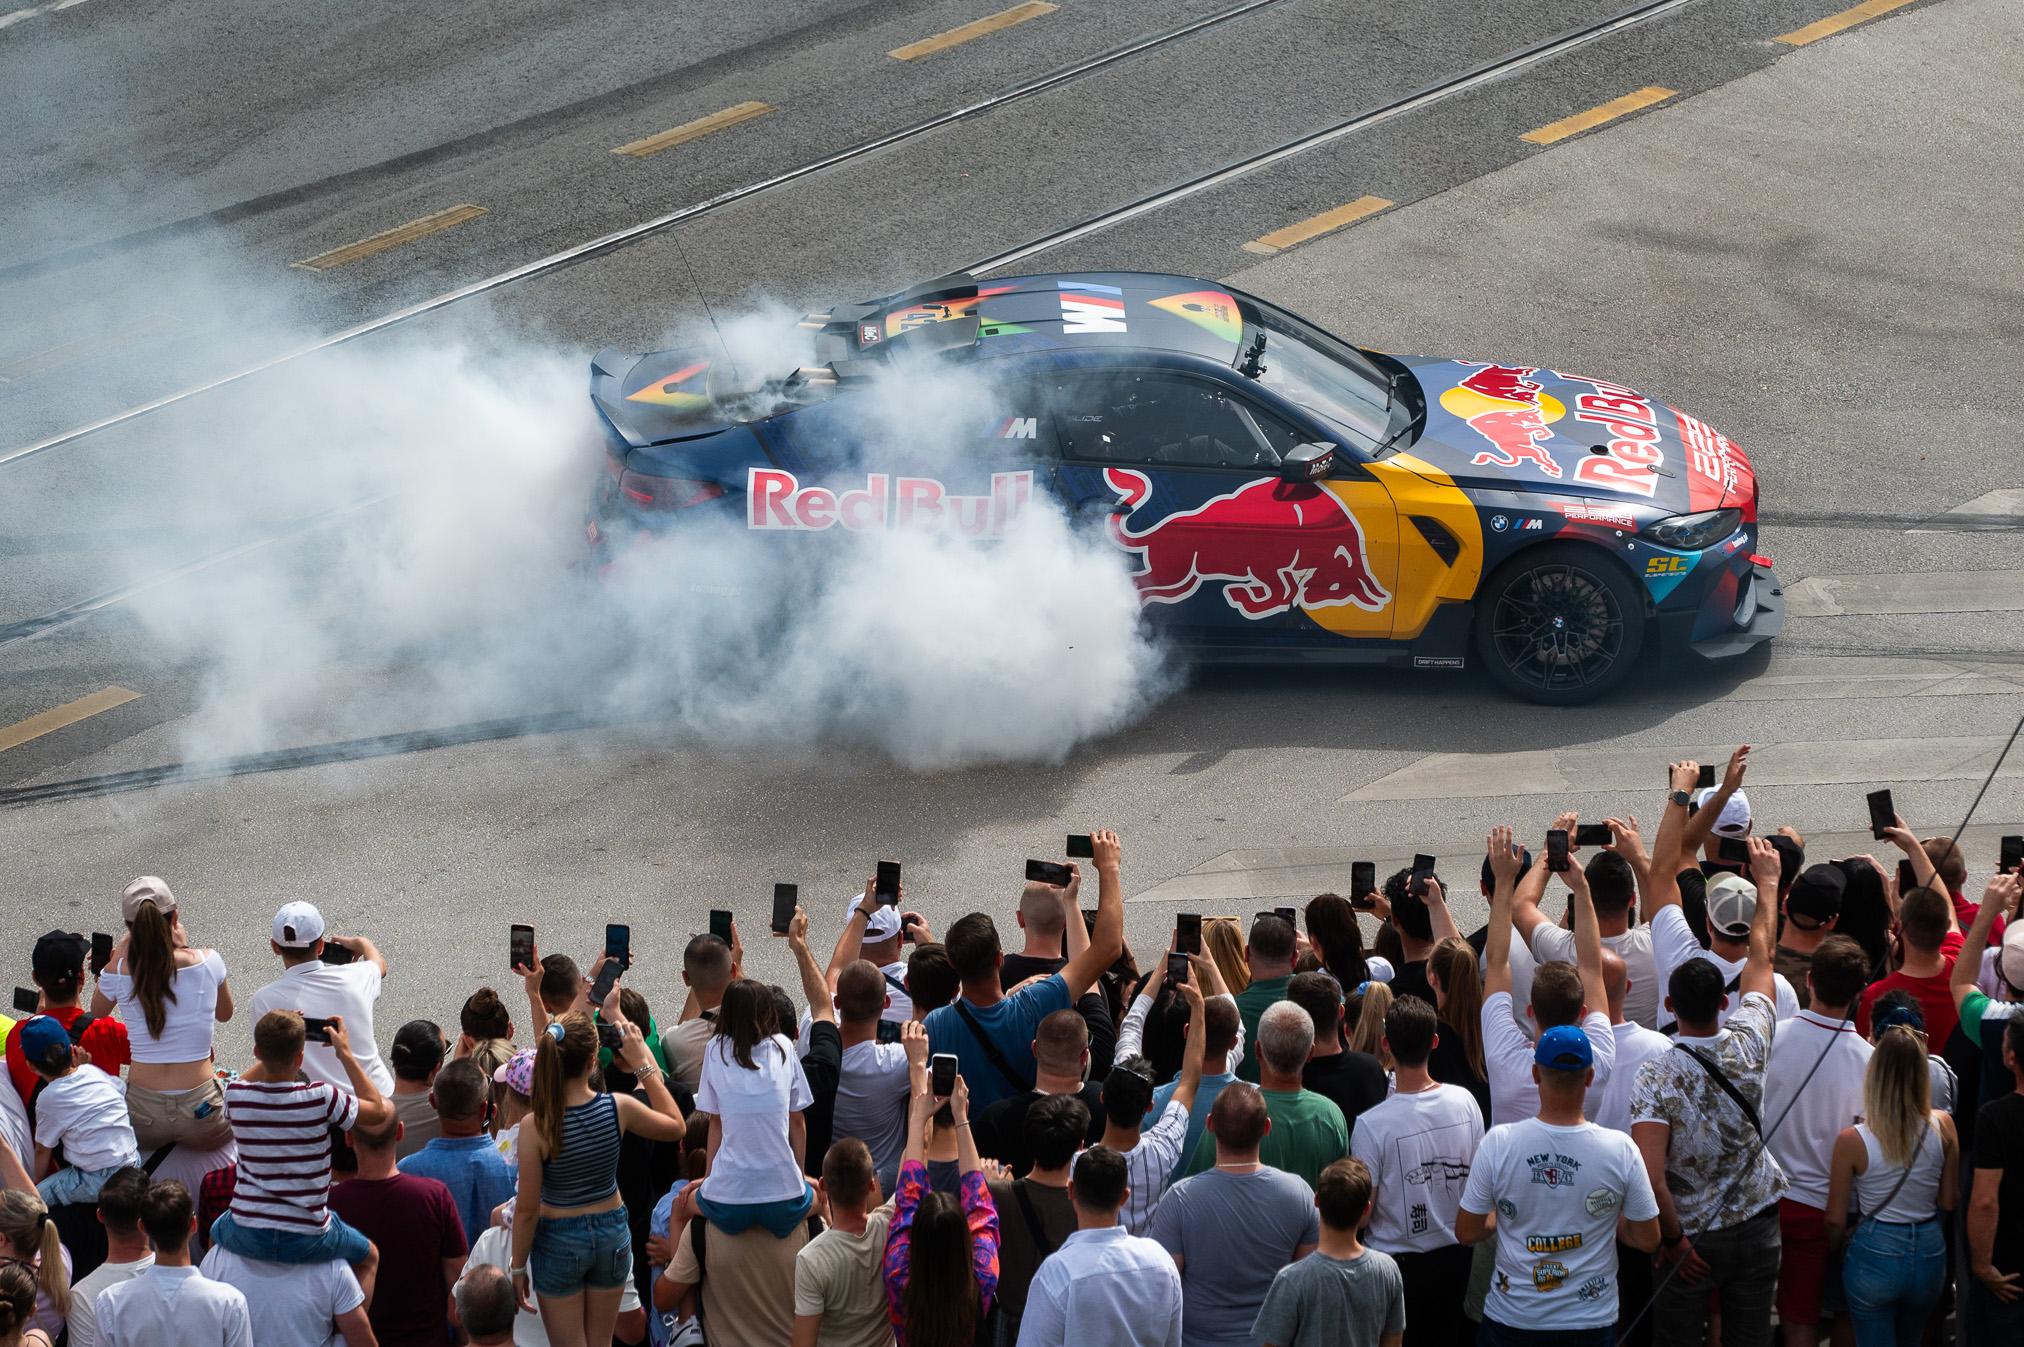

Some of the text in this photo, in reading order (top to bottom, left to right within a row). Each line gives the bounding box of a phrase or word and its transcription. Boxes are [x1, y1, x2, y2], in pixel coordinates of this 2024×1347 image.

[1004, 417, 1037, 439] M
[1550, 370, 1665, 498] Red Bull
[747, 467, 1034, 541] Red Bull
[1526, 519, 1543, 530] M
[1565, 513, 1633, 527] PERFORMANCE
[1526, 1153, 1550, 1168] NEW
[1554, 1153, 1583, 1171] YORK
[1527, 1233, 1582, 1253] COLLEGE
